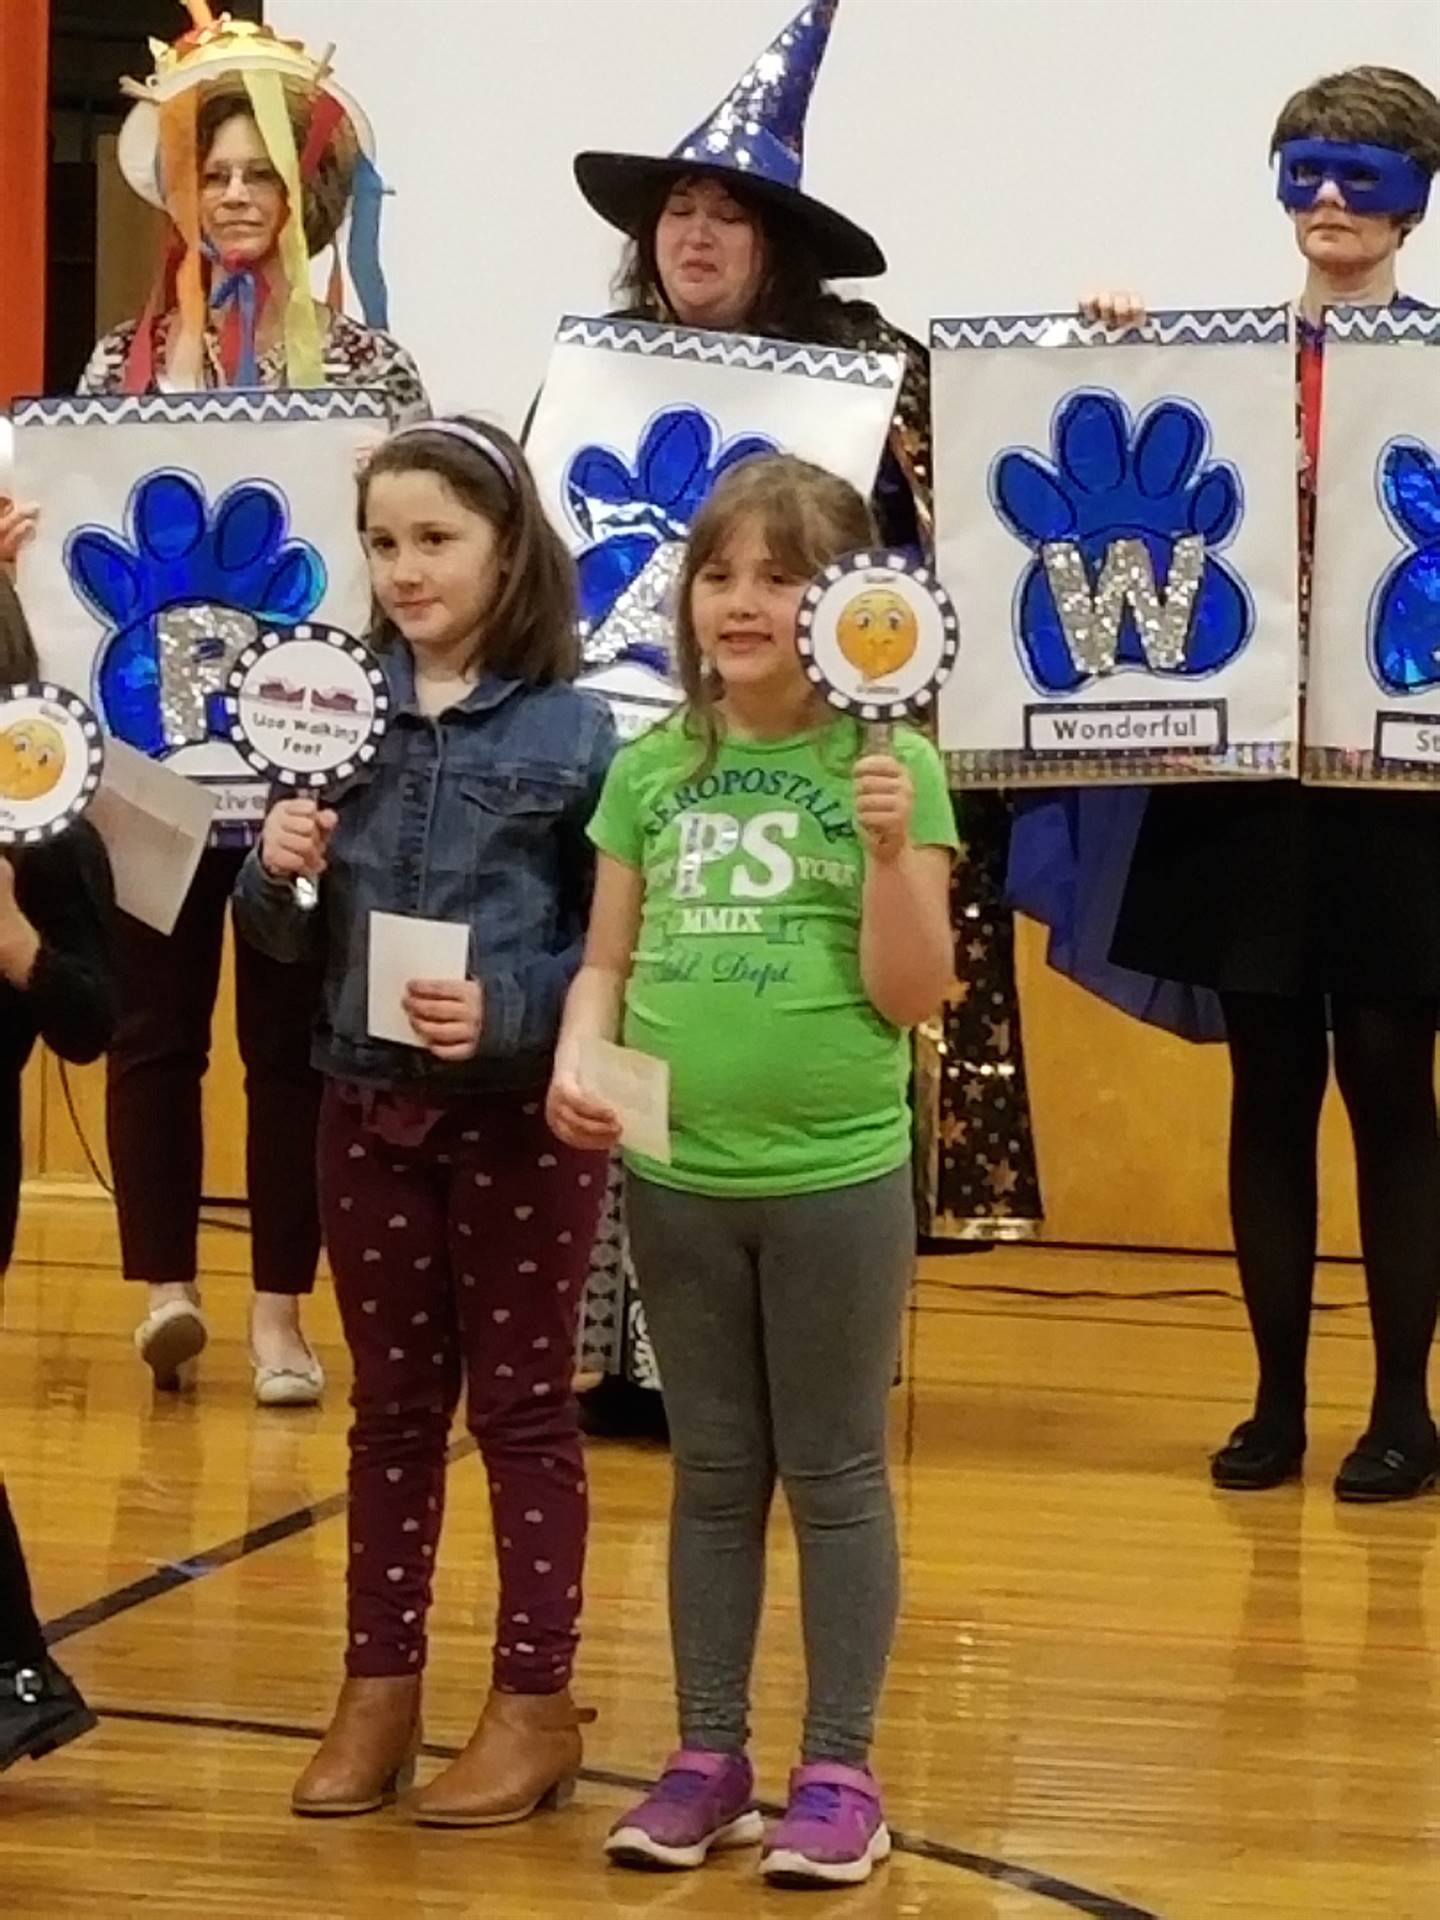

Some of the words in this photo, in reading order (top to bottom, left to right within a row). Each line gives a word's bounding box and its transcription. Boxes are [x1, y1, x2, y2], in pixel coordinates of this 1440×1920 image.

[1042, 533, 1204, 674] W
[156, 605, 258, 742] P
[252, 711, 287, 730] Use
[292, 719, 359, 745] Walking
[1053, 713, 1198, 741] Wonderful
[282, 737, 322, 757] Feet
[670, 810, 800, 899] PS
[679, 906, 764, 934] MMIX
